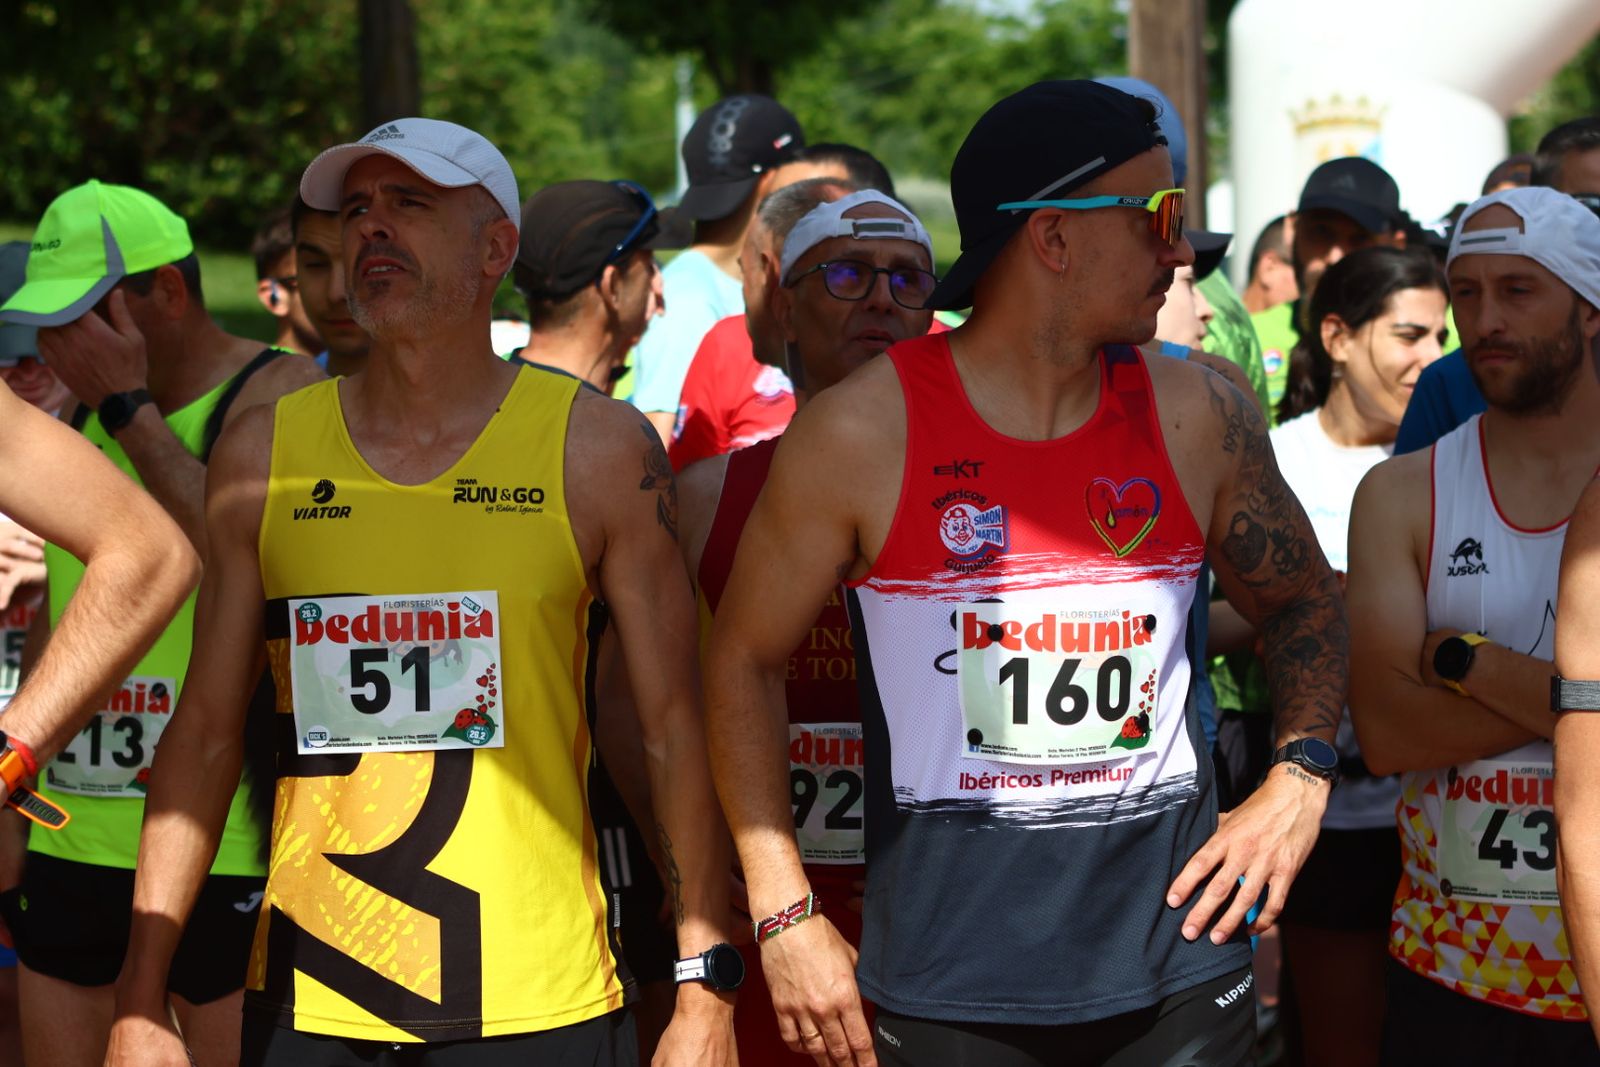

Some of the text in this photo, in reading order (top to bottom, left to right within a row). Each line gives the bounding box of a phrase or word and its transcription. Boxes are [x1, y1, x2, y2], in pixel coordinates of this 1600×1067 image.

[933, 459, 984, 479] EKT
[293, 506, 352, 520] VIATOR
[974, 508, 1001, 526] SIMON
[975, 528, 1003, 545] MARTIN
[383, 598, 445, 609] FLORISTERÍAS
[1060, 608, 1120, 620] FLORISTERÍAS
[294, 602, 494, 646] bedunia
[962, 610, 1153, 653] bedunia
[349, 646, 431, 715] 51
[999, 655, 1132, 726] 160
[959, 771, 1043, 790] Ibéricos
[1286, 767, 1318, 786] Mario
[790, 769, 863, 830] 92
[1478, 809, 1557, 872] 43
